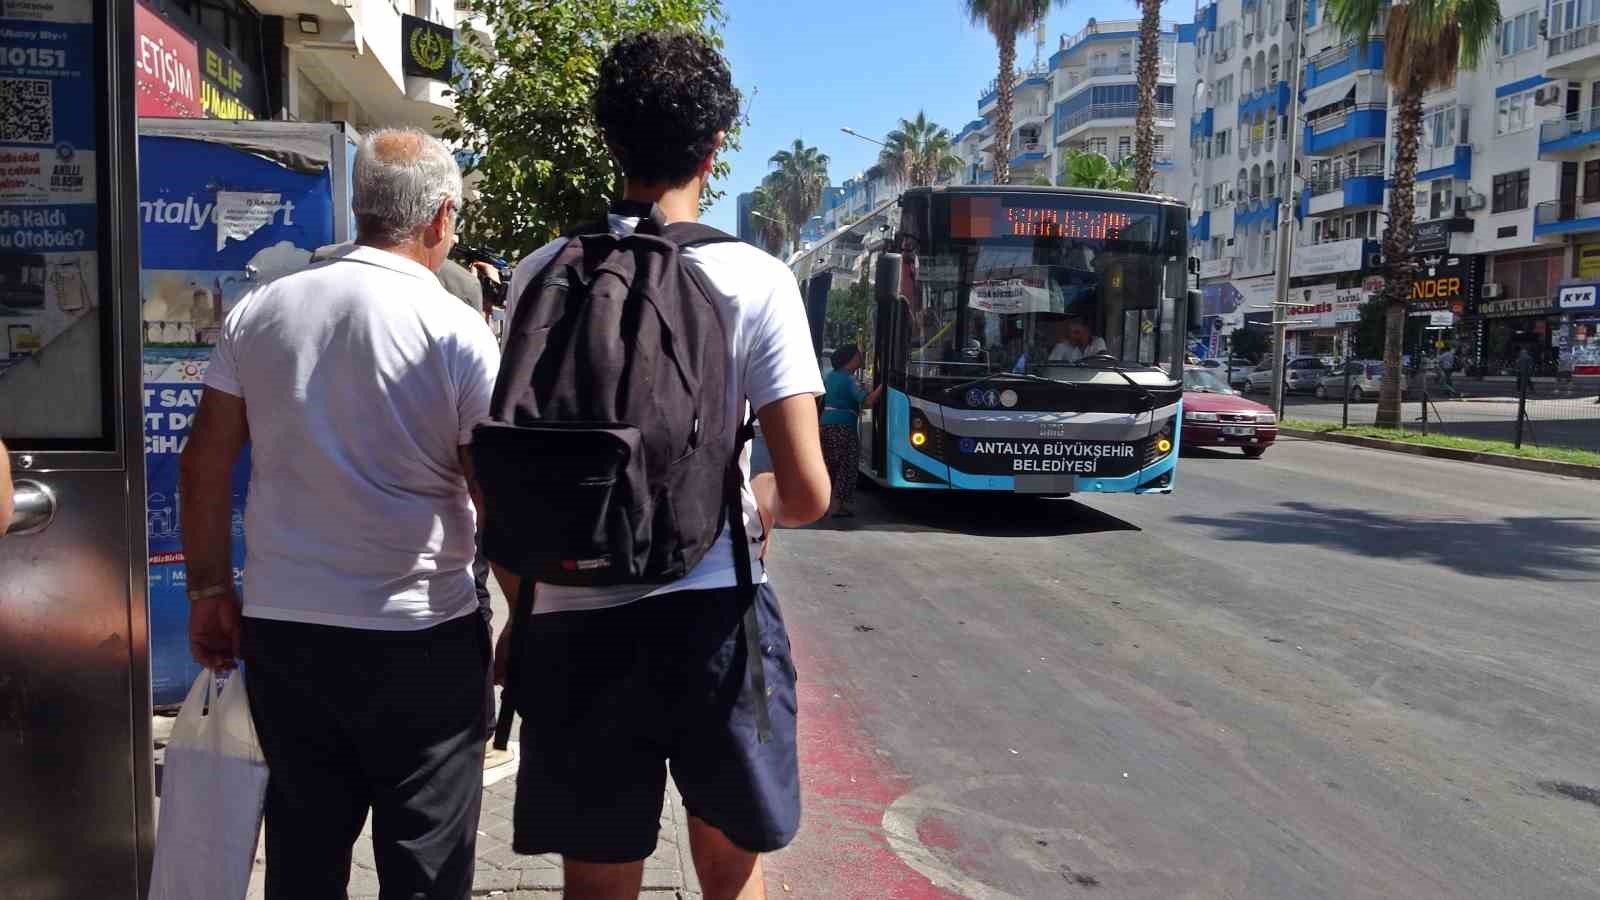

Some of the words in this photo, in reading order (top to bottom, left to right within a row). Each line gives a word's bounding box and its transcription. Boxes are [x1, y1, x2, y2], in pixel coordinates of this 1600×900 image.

[136, 35, 194, 102] ETİŞİM
[205, 47, 244, 93] ELİF
[14, 228, 85, 248] Otobüs?
[973, 441, 1040, 456] ANTALYA
[1043, 440, 1135, 459] BÜYÜKŞEHİR
[1012, 457, 1098, 473] BELEDİYESİ
